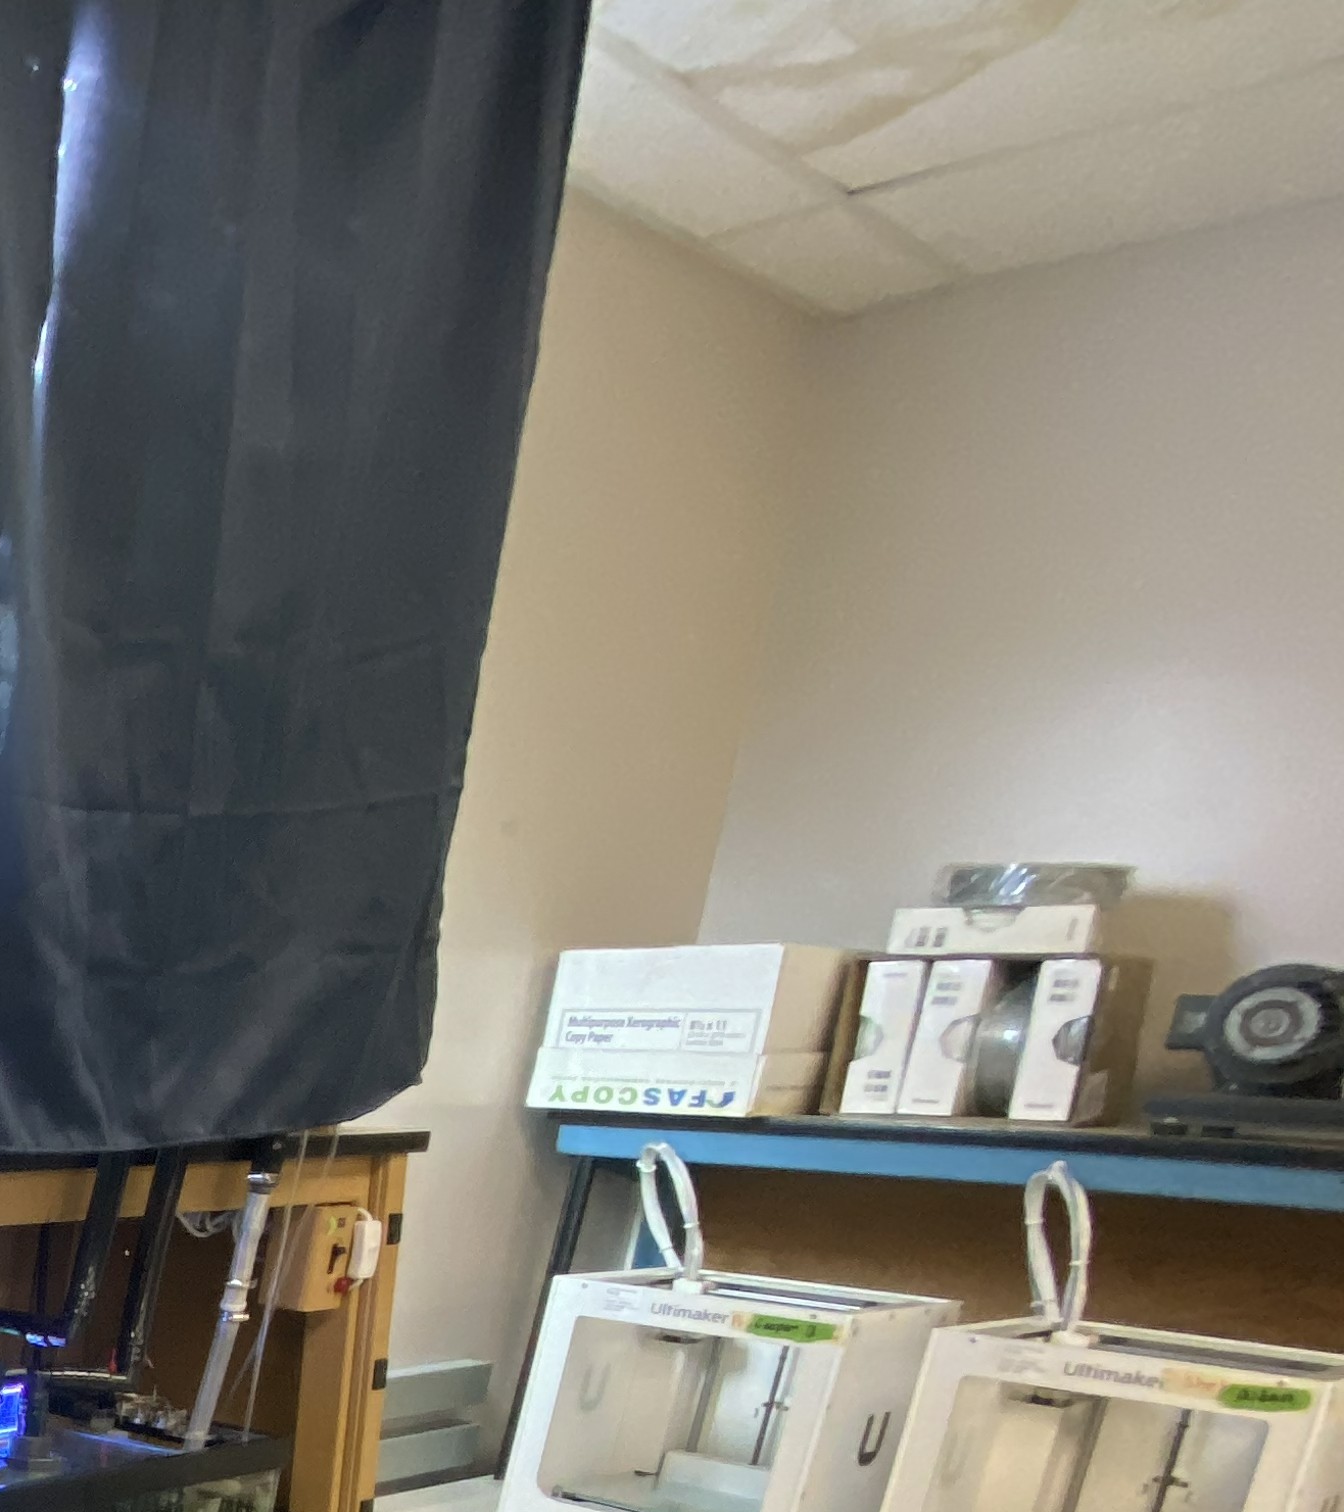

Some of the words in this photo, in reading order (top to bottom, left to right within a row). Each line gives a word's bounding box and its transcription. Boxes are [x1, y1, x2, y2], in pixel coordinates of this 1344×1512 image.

[565, 1031, 588, 1044] Copy
[588, 1031, 614, 1044] Paper
[548, 1085, 708, 1108] FASCOPY
[649, 1302, 730, 1325] Ultimaker
[1063, 1360, 1165, 1390] Ultimake
